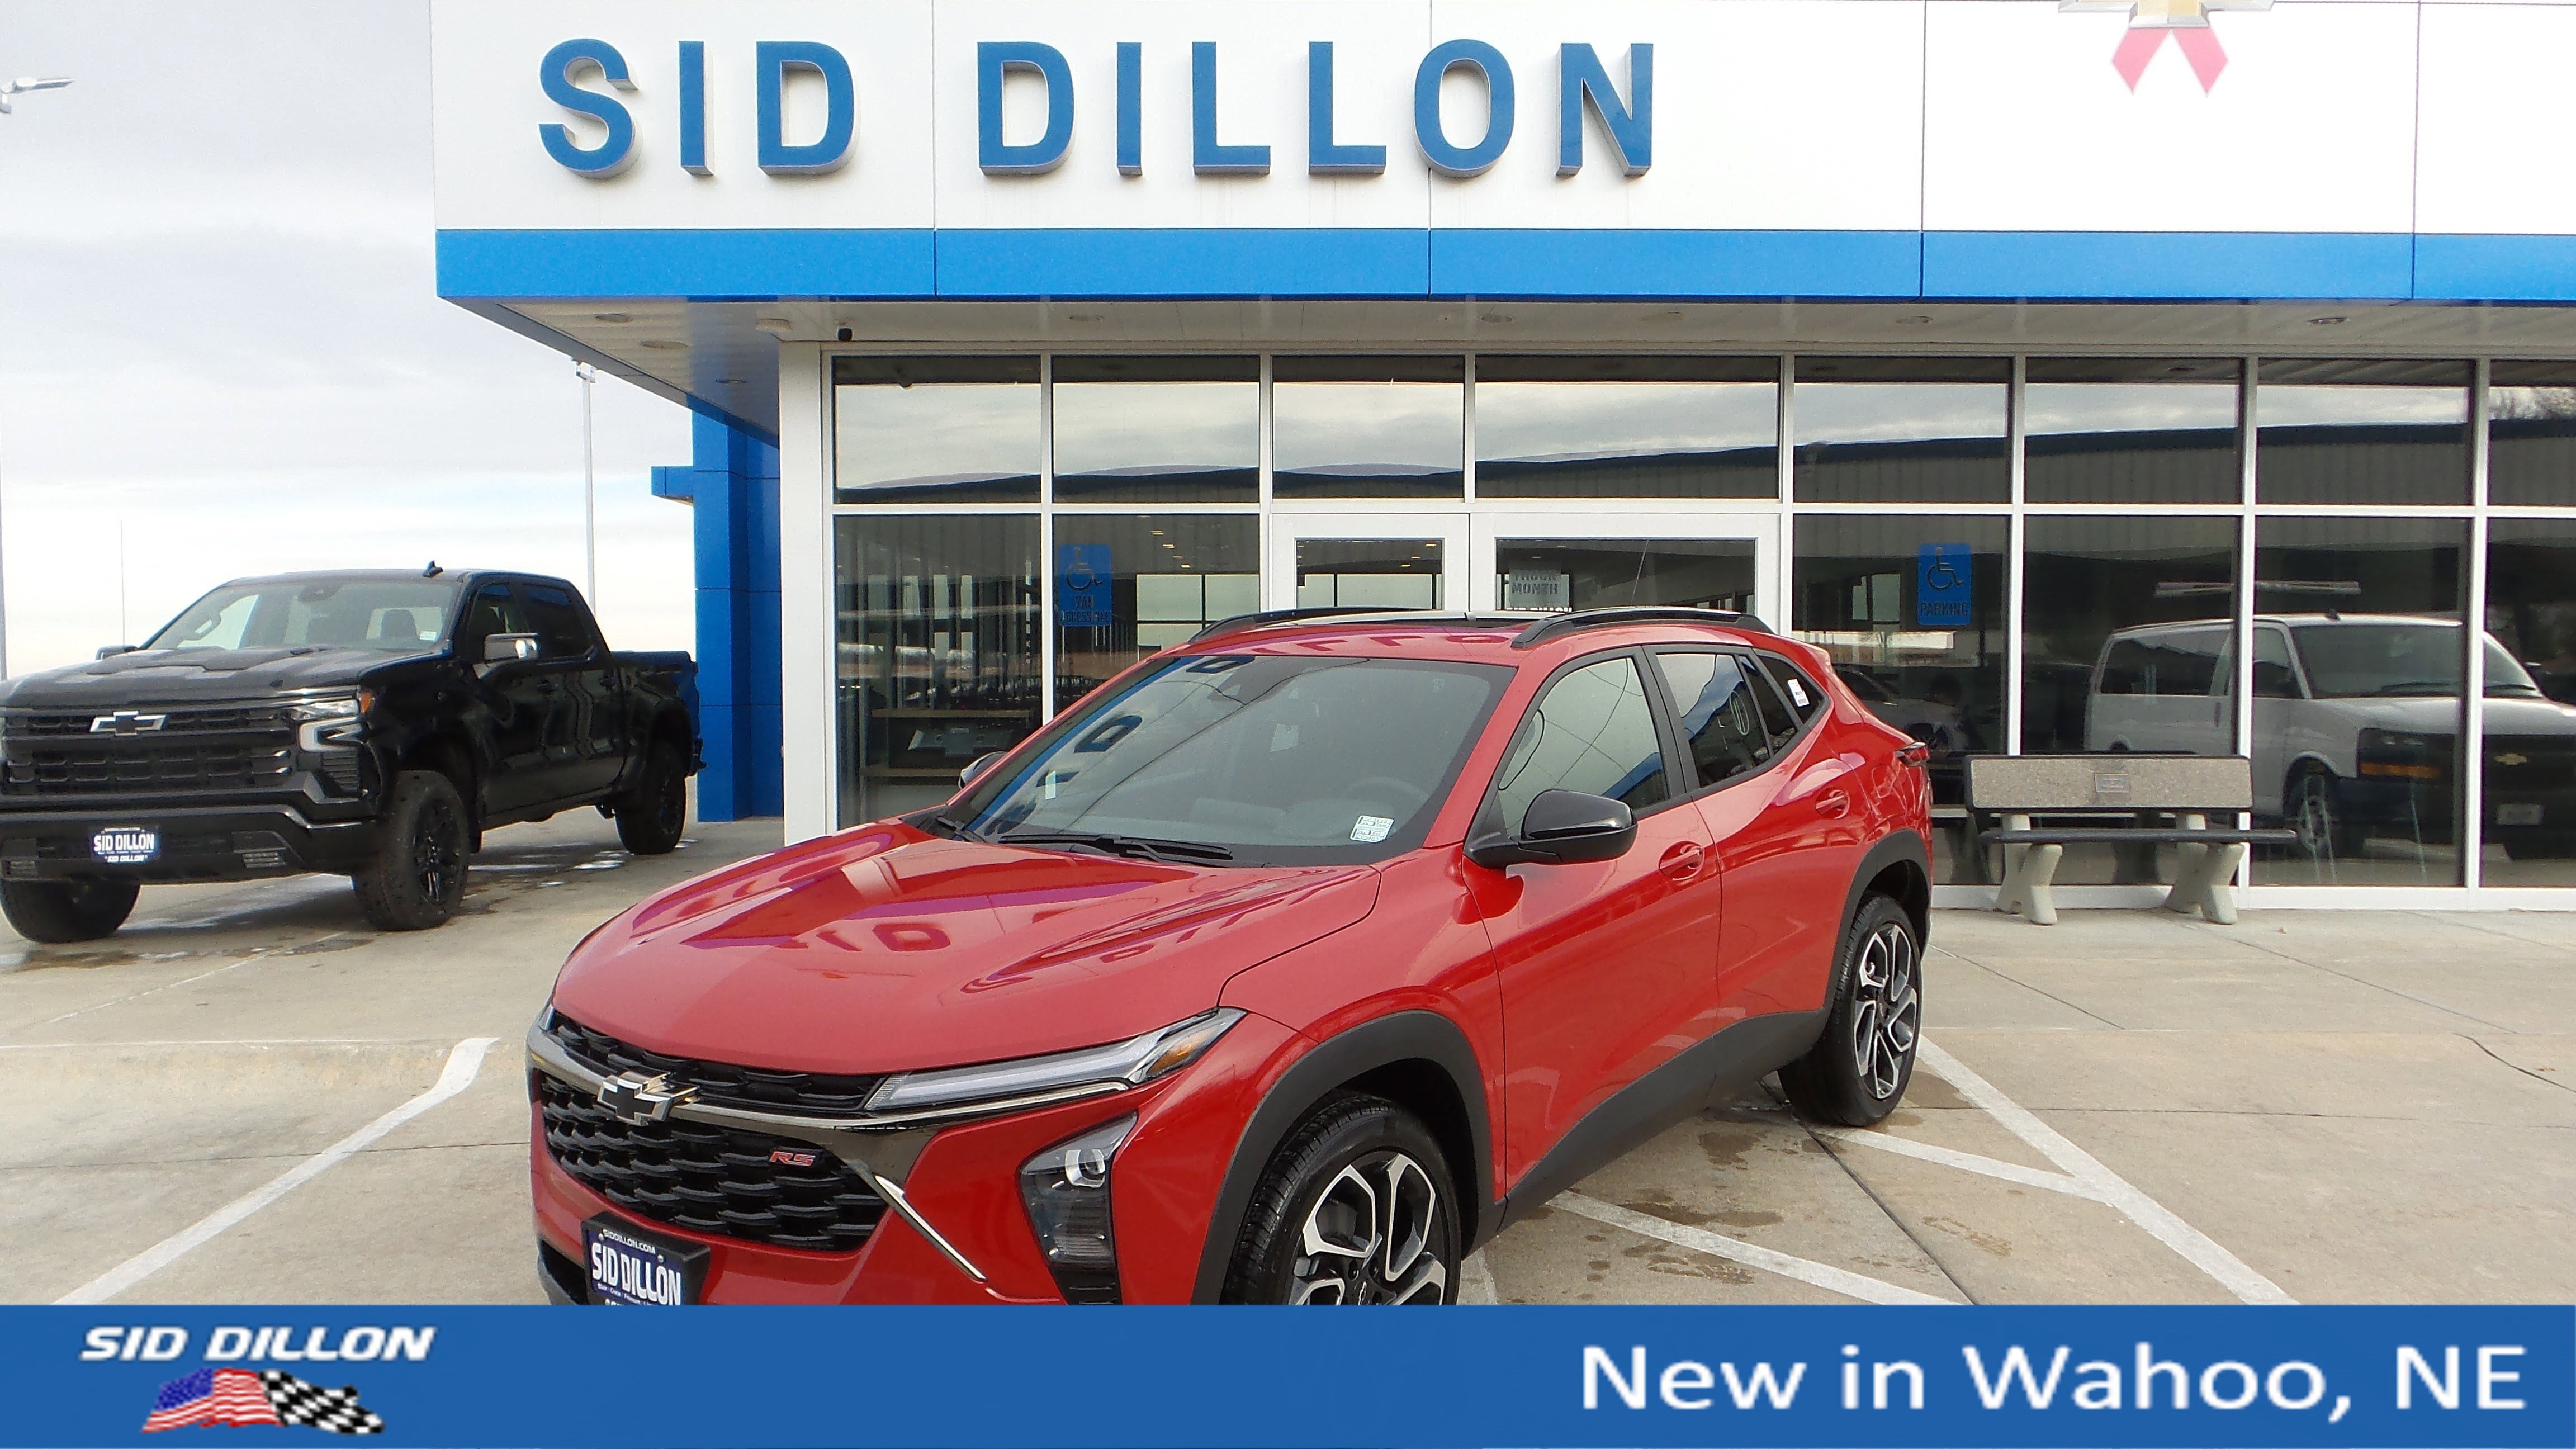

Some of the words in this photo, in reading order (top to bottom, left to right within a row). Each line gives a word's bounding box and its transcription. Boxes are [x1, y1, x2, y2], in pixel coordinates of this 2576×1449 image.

[538, 37, 860, 179] SID
[977, 38, 1653, 179] DILLON
[1512, 583, 1559, 594] MONTH
[1075, 595, 1094, 608] VAN
[1919, 602, 1969, 616] PARKING
[94, 835, 113, 851] SID
[115, 833, 154, 850] DILLON
[769, 1151, 816, 1167] RS
[603, 1229, 656, 1255] SIDDILLON.COM
[591, 1242, 618, 1287] SID
[621, 1253, 681, 1306] DILLON
